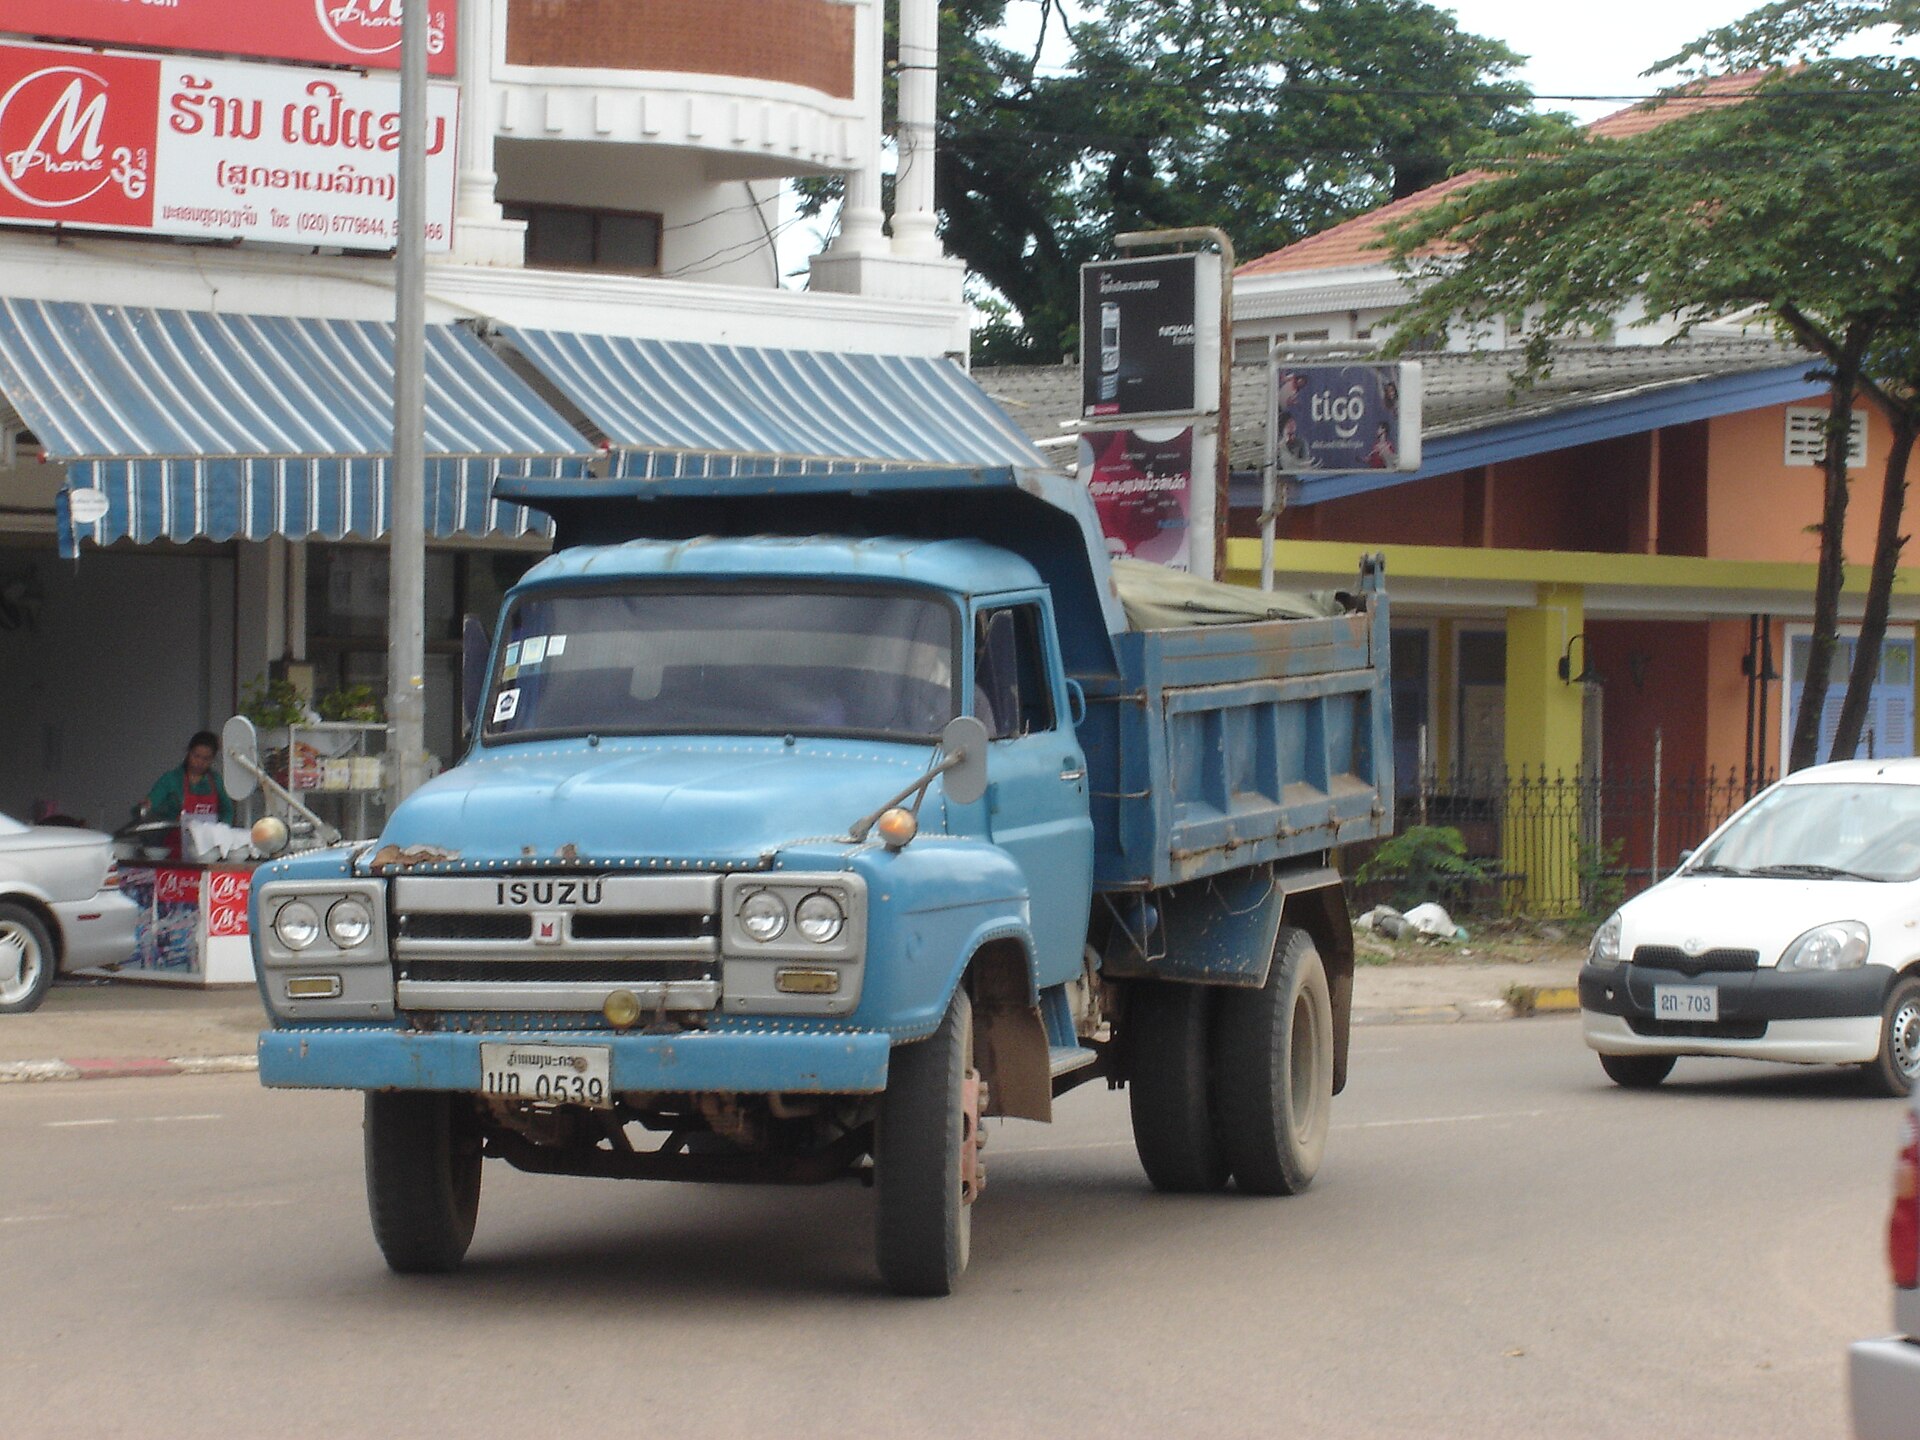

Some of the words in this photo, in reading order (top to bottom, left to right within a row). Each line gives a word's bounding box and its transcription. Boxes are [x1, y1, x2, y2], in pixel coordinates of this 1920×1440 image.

[169, 74, 263, 140] ຮ້ານ
[5, 150, 104, 180] Phone
[111, 146, 148, 200] 3G
[297, 211, 329, 236] (020)
[496, 881, 604, 906] ISUZU
[1686, 994, 1712, 1013] 703
[535, 1074, 603, 1105] 0539
